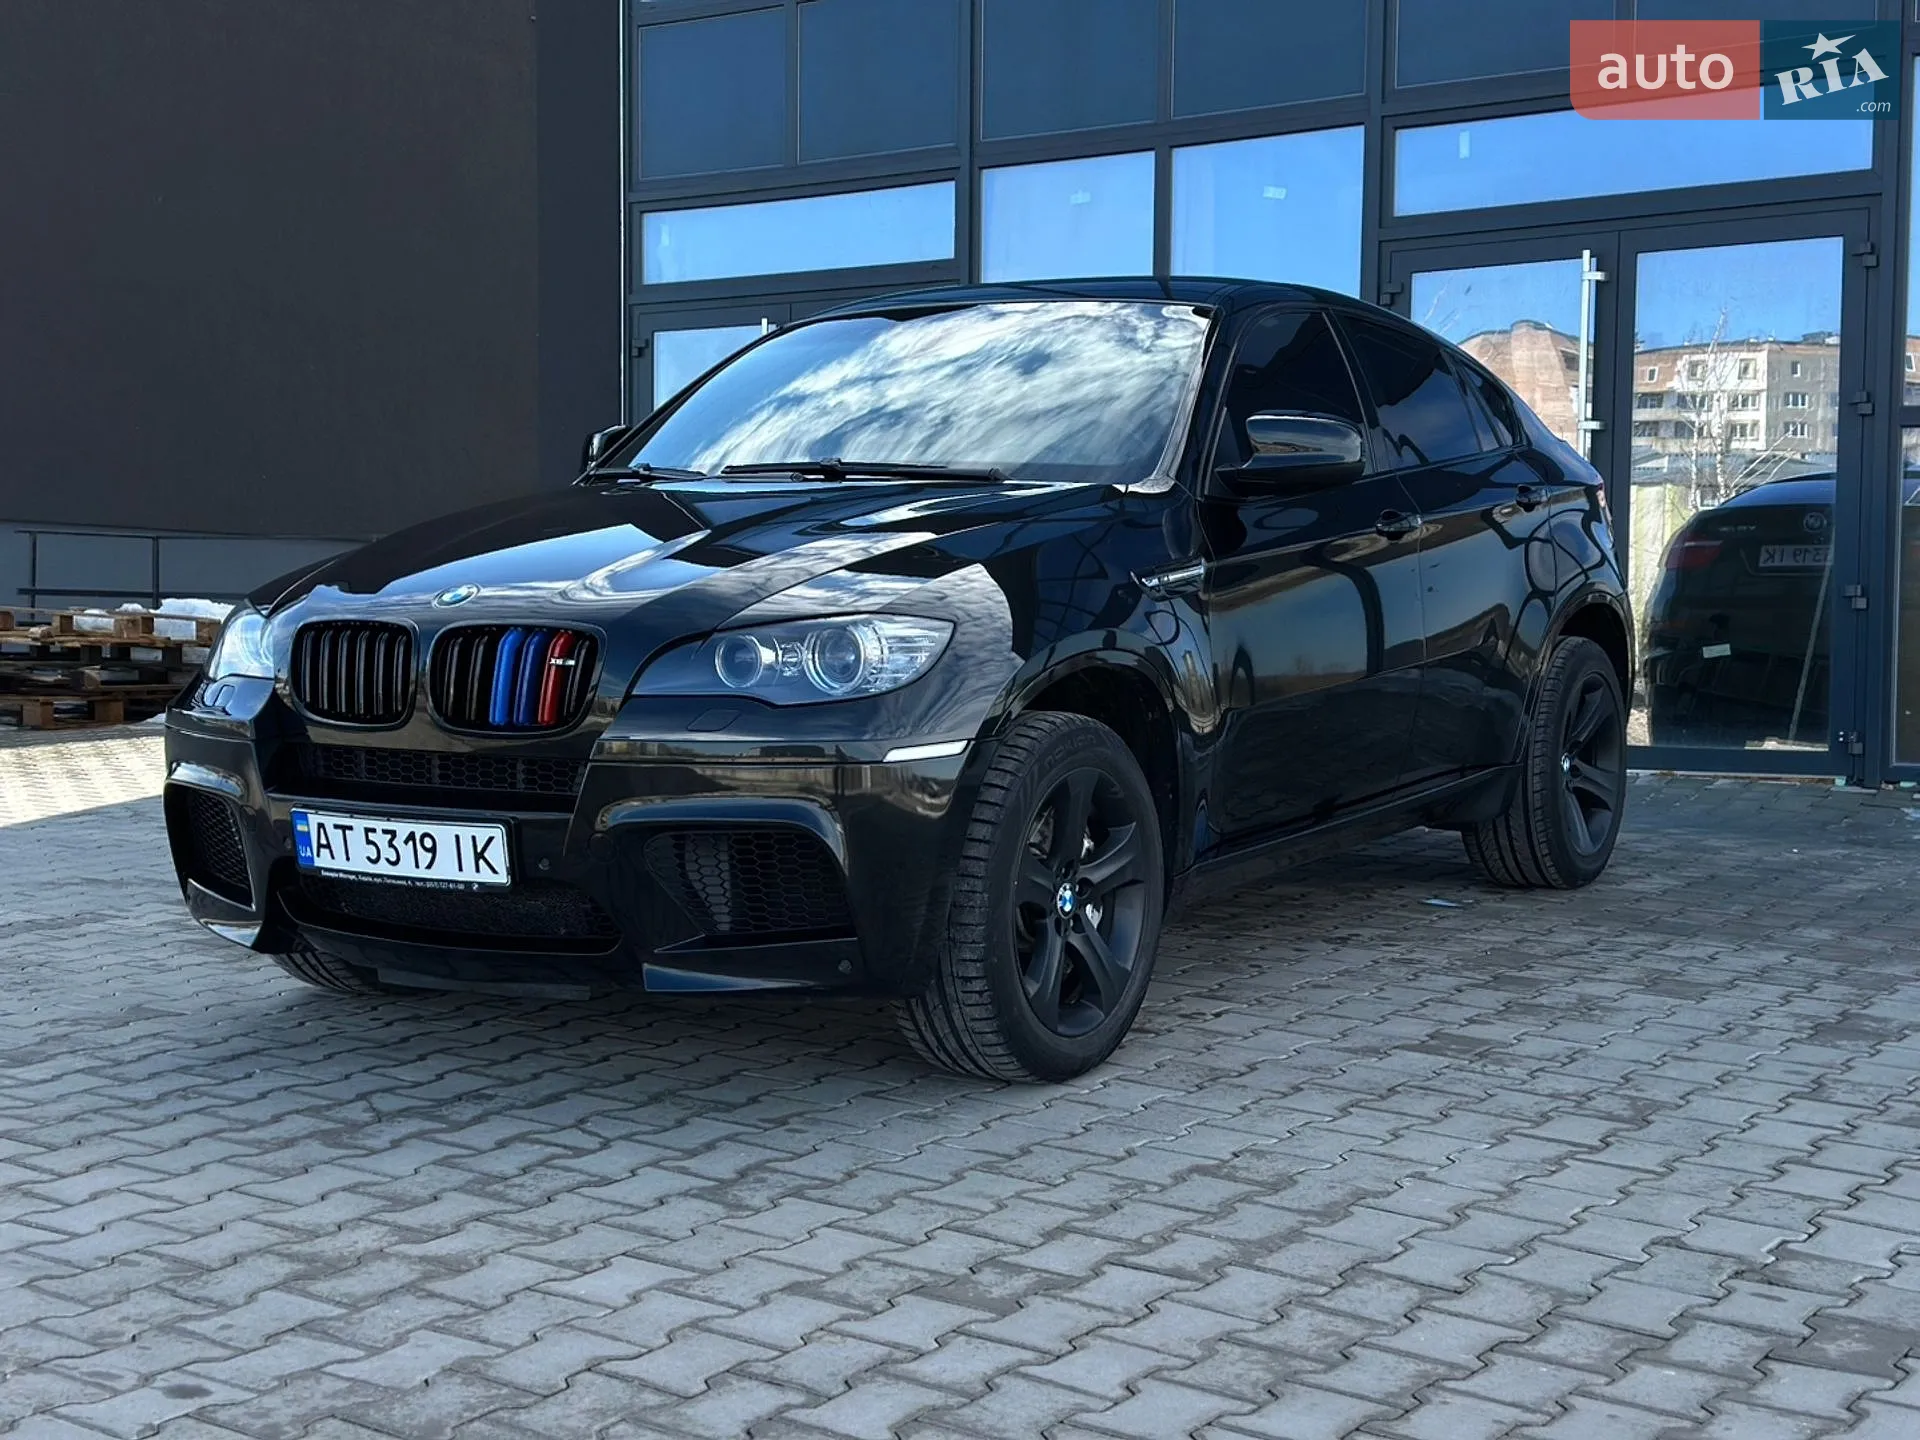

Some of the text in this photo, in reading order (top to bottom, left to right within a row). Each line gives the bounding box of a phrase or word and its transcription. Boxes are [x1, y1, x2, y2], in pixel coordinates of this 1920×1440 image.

[299, 847, 313, 858] UA
[316, 822, 499, 875] AT 5319 IK
